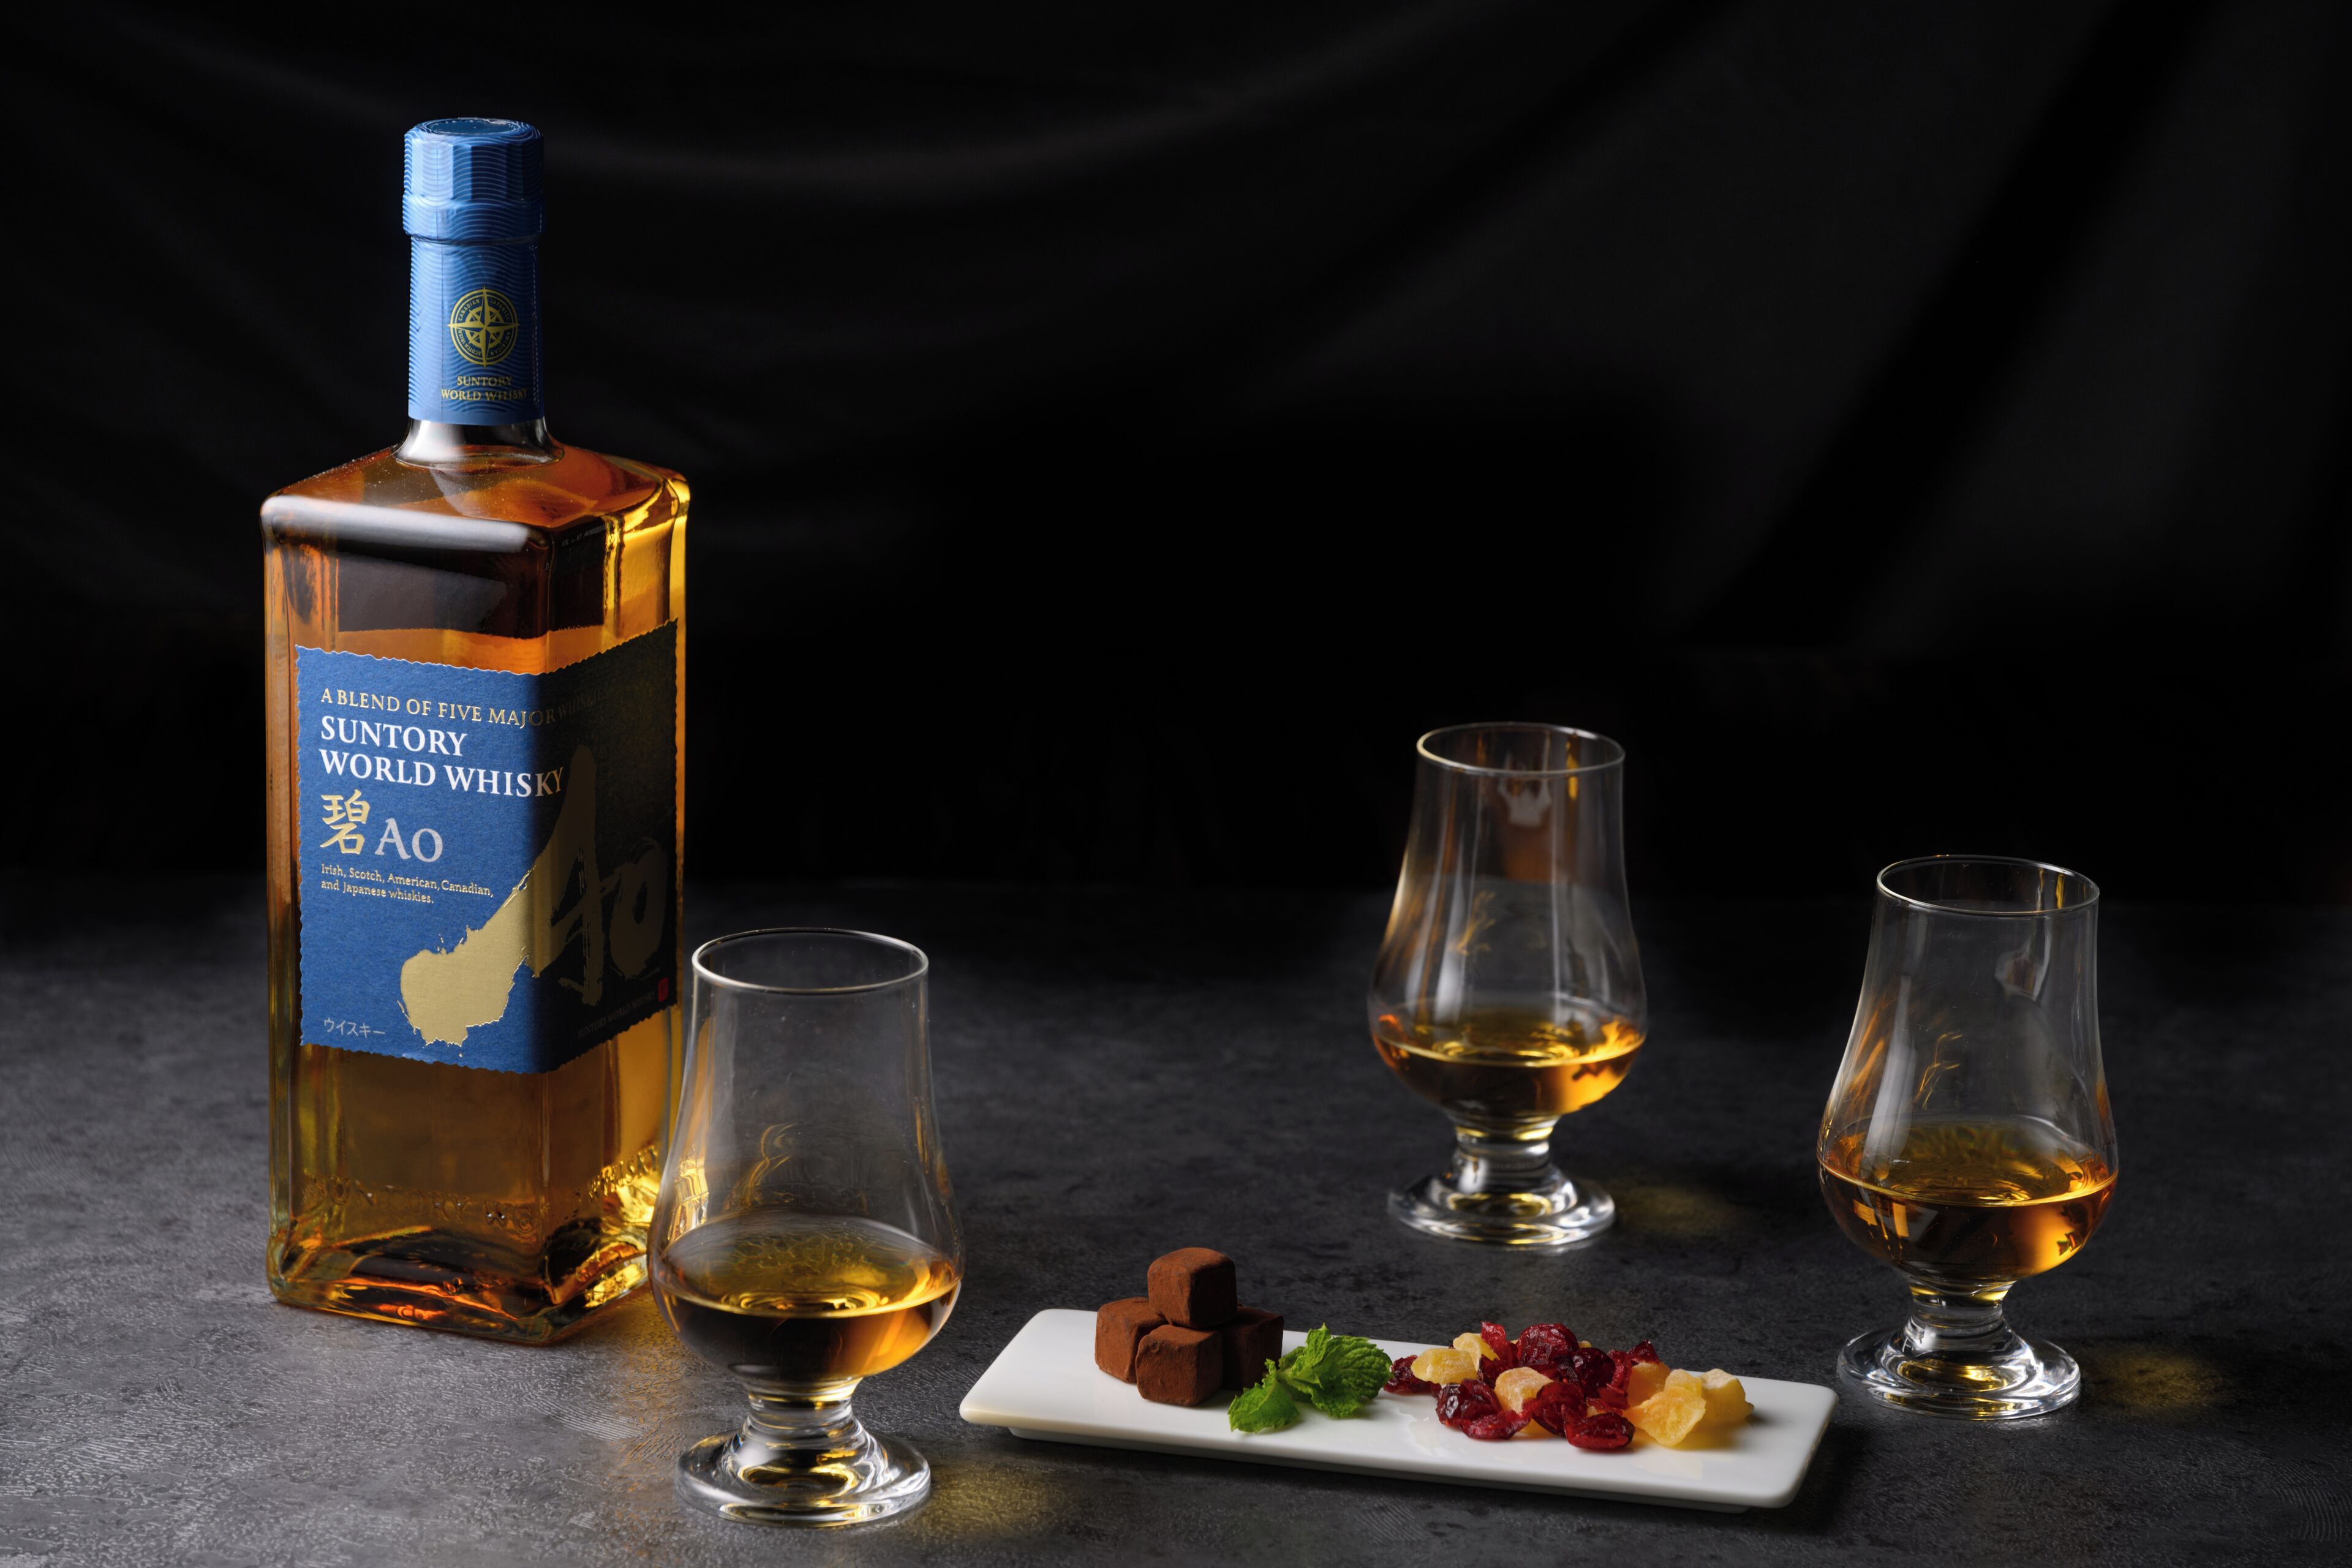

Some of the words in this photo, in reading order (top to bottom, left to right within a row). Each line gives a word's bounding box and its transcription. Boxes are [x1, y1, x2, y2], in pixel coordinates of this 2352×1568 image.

[441, 388, 481, 401] WORLD
[484, 388, 528, 401] WHISKY
[457, 375, 513, 388] SUNTORY
[321, 688, 333, 703] A
[337, 690, 400, 712] BLEND
[406, 698, 432, 717] OF
[438, 703, 482, 722] FIVE
[488, 708, 556, 729] MAJOR
[320, 715, 467, 757] SUNTORY
[319, 748, 436, 786] WORLD
[443, 765, 564, 797] WHISKY
[320, 789, 371, 854] 碧
[321, 864, 346, 878] Irish,
[349, 867, 385, 884] Scotch,
[387, 873, 440, 891] American,
[441, 880, 494, 897] Canadian,
[321, 880, 339, 891] and
[342, 882, 386, 897] Japanese
[388, 890, 434, 903] whiskies.
[323, 1017, 386, 1038] ウイスキー
